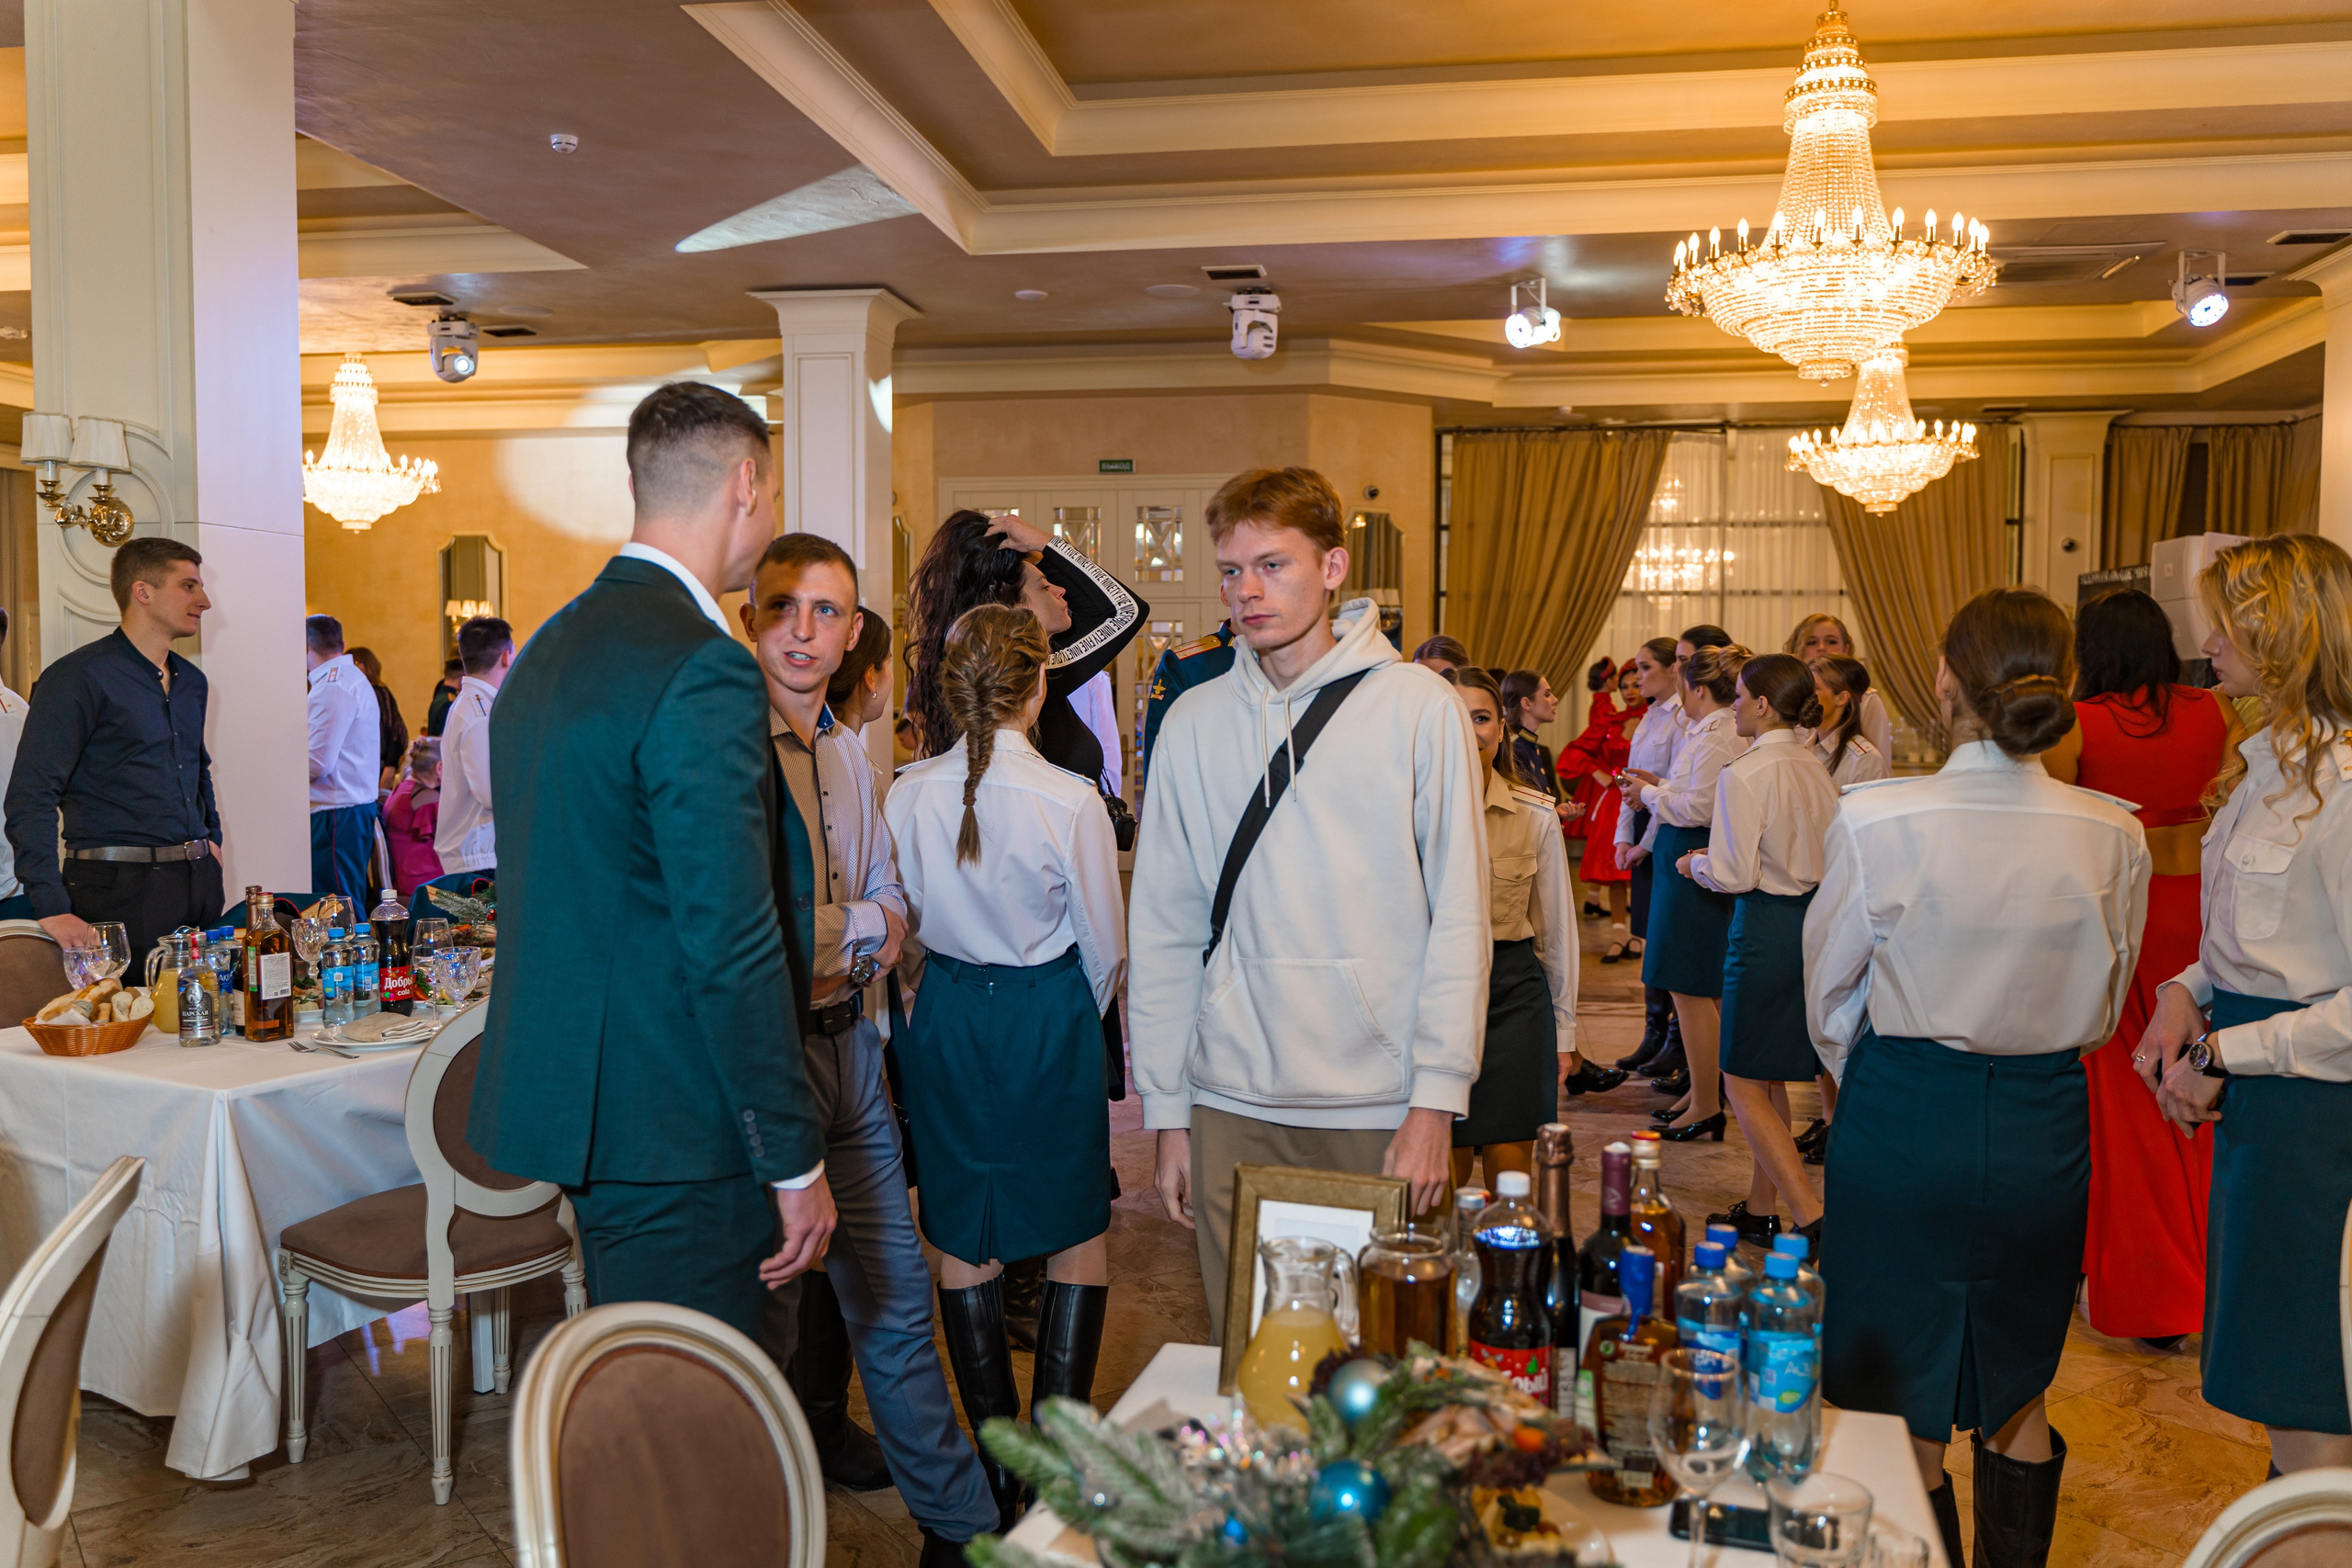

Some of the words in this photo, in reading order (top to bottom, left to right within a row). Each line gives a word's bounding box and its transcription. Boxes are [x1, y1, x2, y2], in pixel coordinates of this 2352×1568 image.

[1102, 462, 1131, 470] ВЫХОД
[1065, 547, 1078, 559] FIVE
[1075, 555, 1096, 572] NINETY
[1091, 569, 1107, 581] FIVE
[1101, 577, 1123, 597] NINETY
[1114, 593, 1132, 606] FIVE
[1092, 623, 1117, 645] NINETY
[1080, 637, 1096, 652] FIVE
[1062, 644, 1083, 662] NINETY
[397, 987, 411, 997] cola
